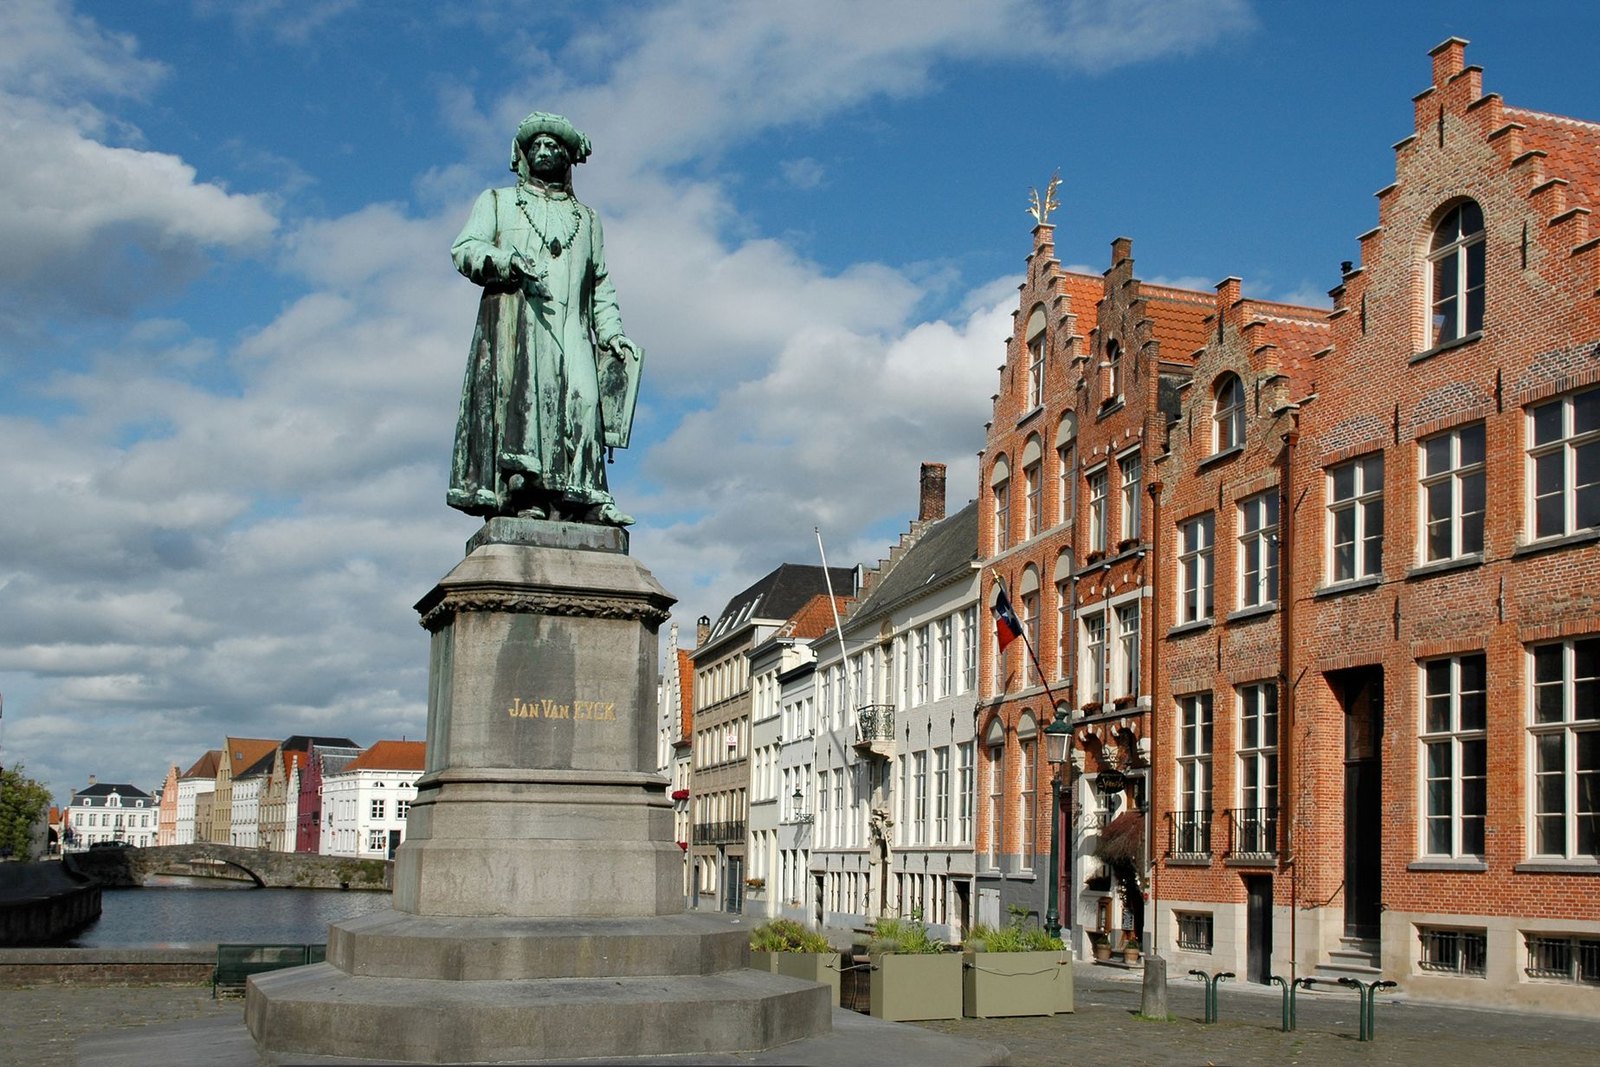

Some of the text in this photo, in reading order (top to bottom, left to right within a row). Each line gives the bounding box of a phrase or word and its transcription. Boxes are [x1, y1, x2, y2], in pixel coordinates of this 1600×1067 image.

[508, 697, 617, 721] JAN VAN EYCK
